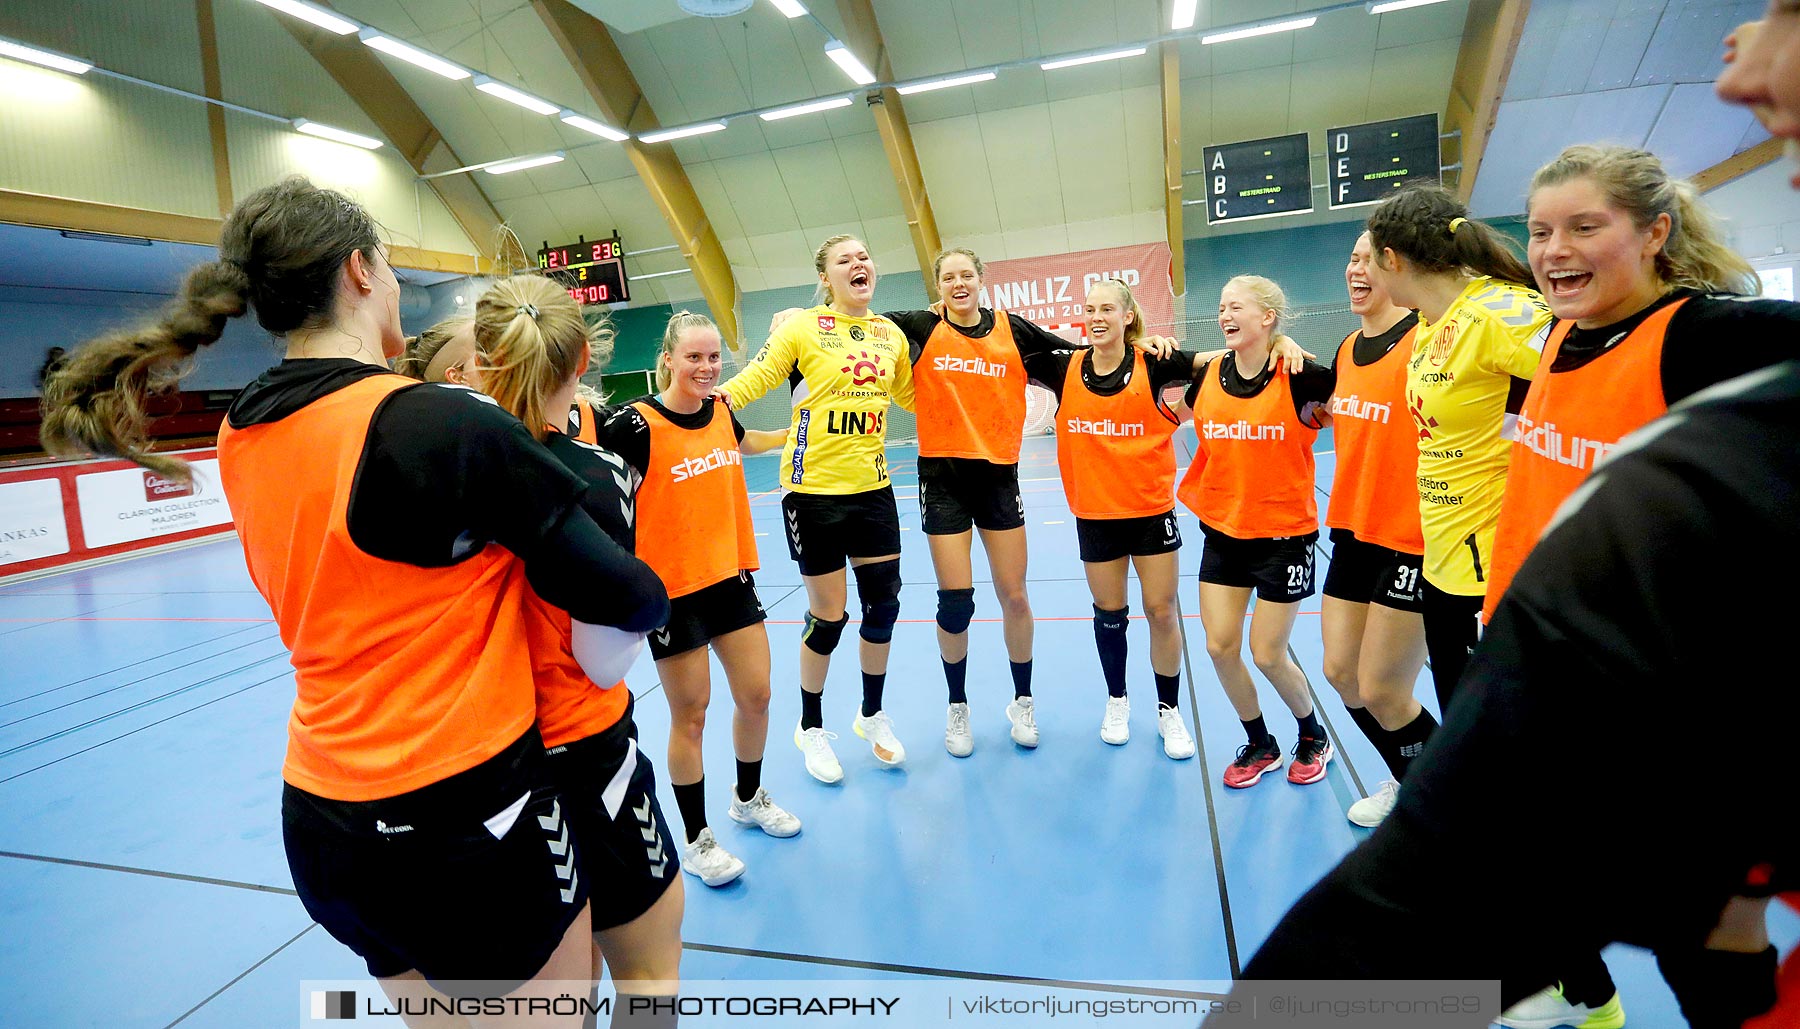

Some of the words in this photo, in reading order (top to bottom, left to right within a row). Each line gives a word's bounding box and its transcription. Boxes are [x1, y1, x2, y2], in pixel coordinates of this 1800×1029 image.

[1336, 133, 1348, 153] D
[1212, 151, 1226, 171] A
[1337, 157, 1350, 178] E
[1364, 168, 1408, 180] WESTERSTRAND
[1214, 175, 1226, 195] B
[1239, 186, 1281, 197] WESTERSTRAND
[1338, 182, 1352, 203] F
[1215, 199, 1228, 218] C
[539, 254, 548, 269] H
[611, 242, 621, 256] G
[579, 267, 587, 280] 2
[933, 354, 1007, 378] stadium
[827, 410, 884, 435] LINDS
[1067, 417, 1145, 437] stadium
[1202, 420, 1285, 441] stadium
[118, 507, 162, 520] CLARION
[164, 498, 220, 513] COLLECTION
[0, 526, 48, 543] NKAS
[1164, 518, 1173, 537] 6
[1464, 533, 1485, 582] 1
[1287, 565, 1303, 587] 23
[1394, 565, 1418, 592] 31
